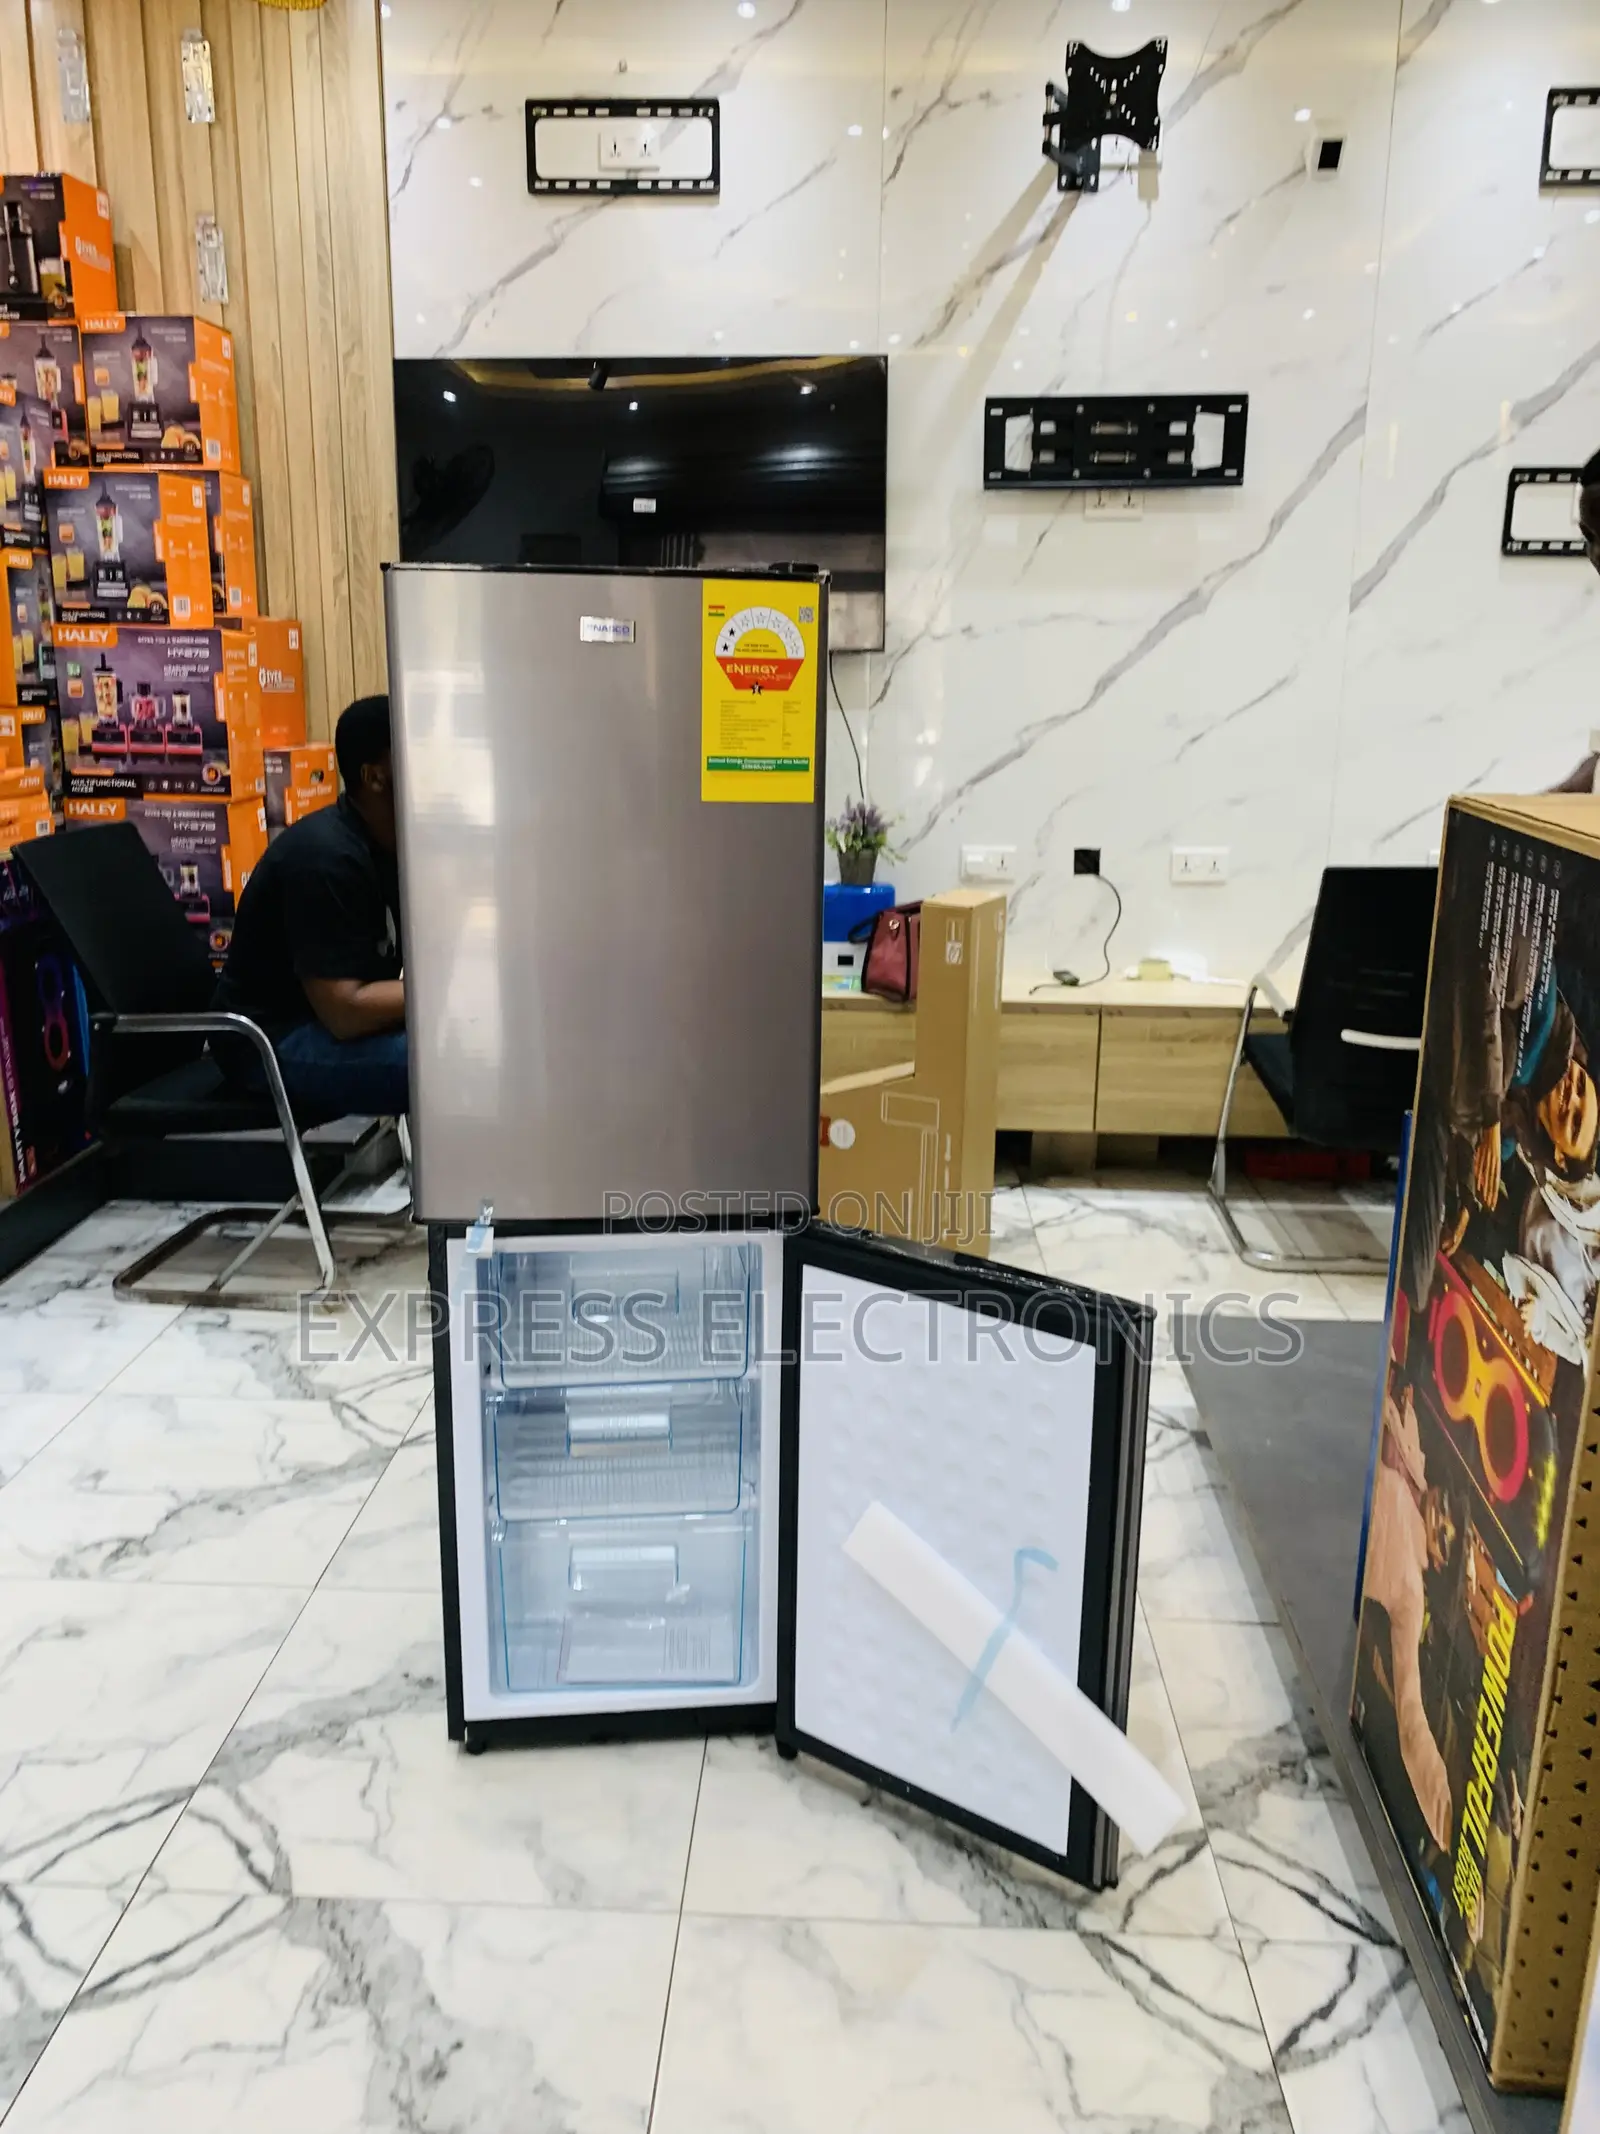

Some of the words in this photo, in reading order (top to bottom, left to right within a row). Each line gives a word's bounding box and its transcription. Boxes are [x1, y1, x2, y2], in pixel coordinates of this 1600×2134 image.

[48, 475, 83, 487] HALEY
[58, 628, 109, 643] HALEY
[726, 664, 779, 676] ENERGY
[71, 779, 137, 788] MULTIFUNCTIONAL
[68, 801, 117, 817] HALEY
[1462, 1588, 1518, 1861] POWERFUL
[1451, 1832, 1475, 1921] BOOST
